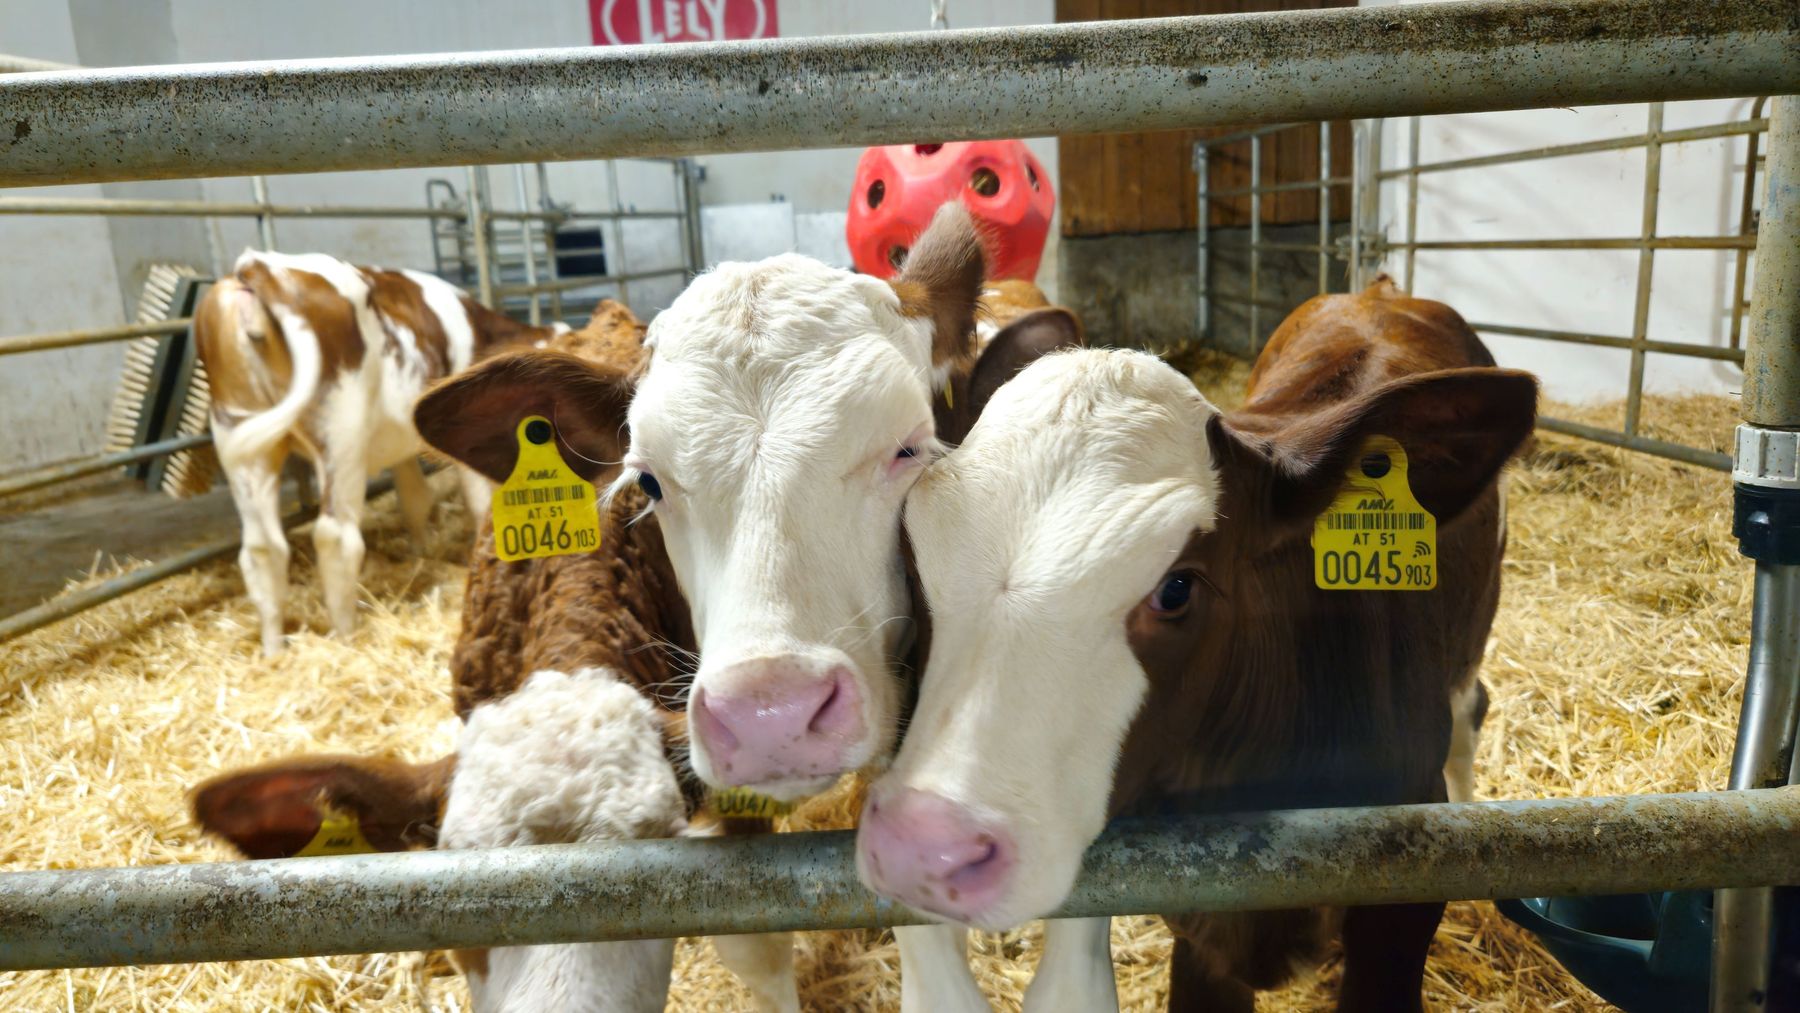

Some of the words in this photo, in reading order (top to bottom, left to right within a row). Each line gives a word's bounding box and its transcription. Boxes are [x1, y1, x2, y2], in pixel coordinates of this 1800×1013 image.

[527, 508, 541, 520] AT
[550, 506, 563, 518] 51
[503, 520, 571, 556] 0046
[574, 529, 596, 548] 103
[1353, 533, 1370, 545] AT
[1380, 533, 1396, 545] 51
[1323, 550, 1402, 585] 0045
[1405, 565, 1431, 586] 903
